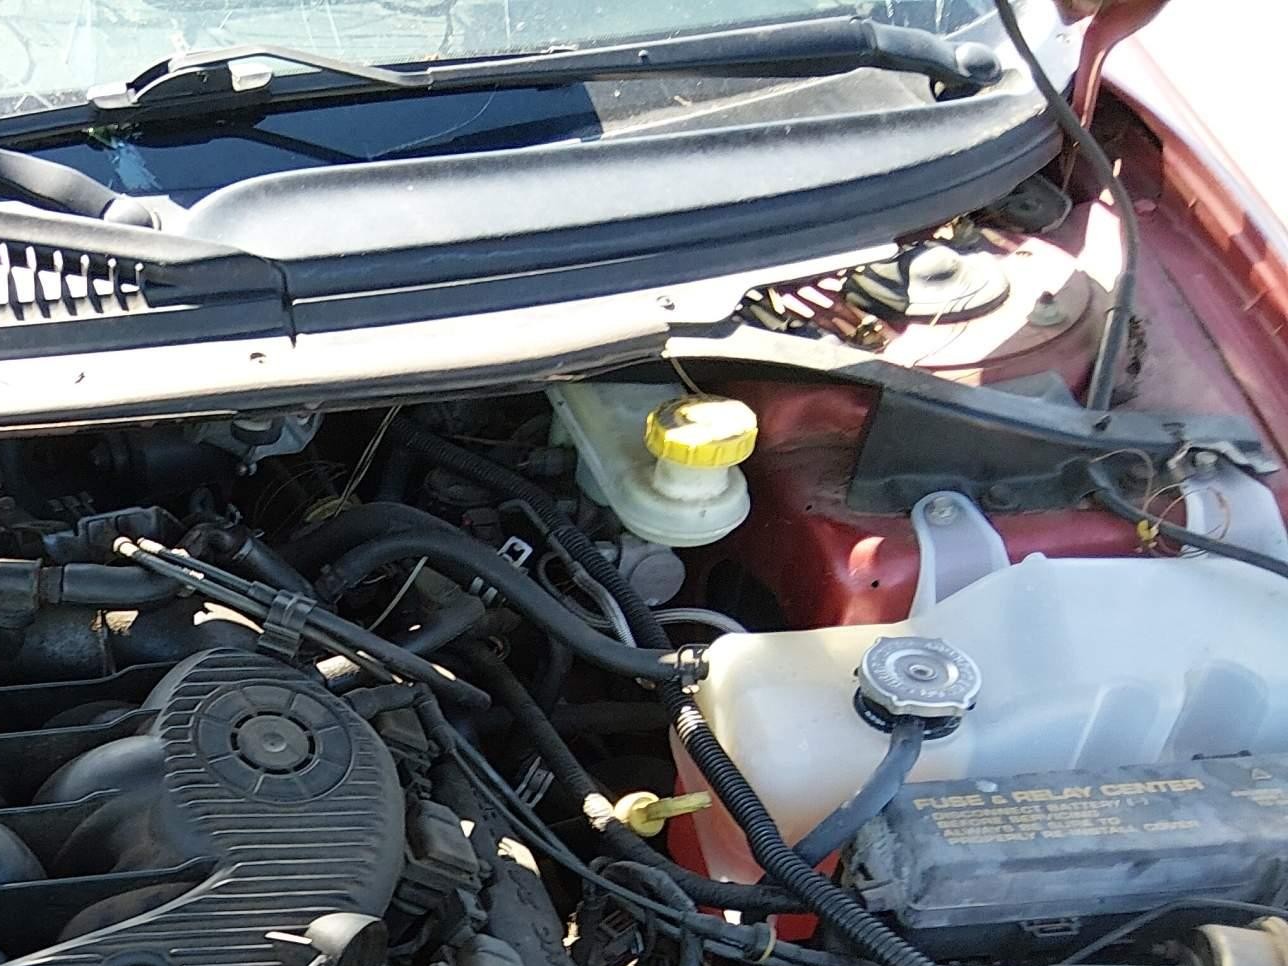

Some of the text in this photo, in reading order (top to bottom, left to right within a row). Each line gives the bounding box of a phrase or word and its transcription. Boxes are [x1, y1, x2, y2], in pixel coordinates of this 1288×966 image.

[913, 779, 1204, 810] FUSE & RELAY CENTER
